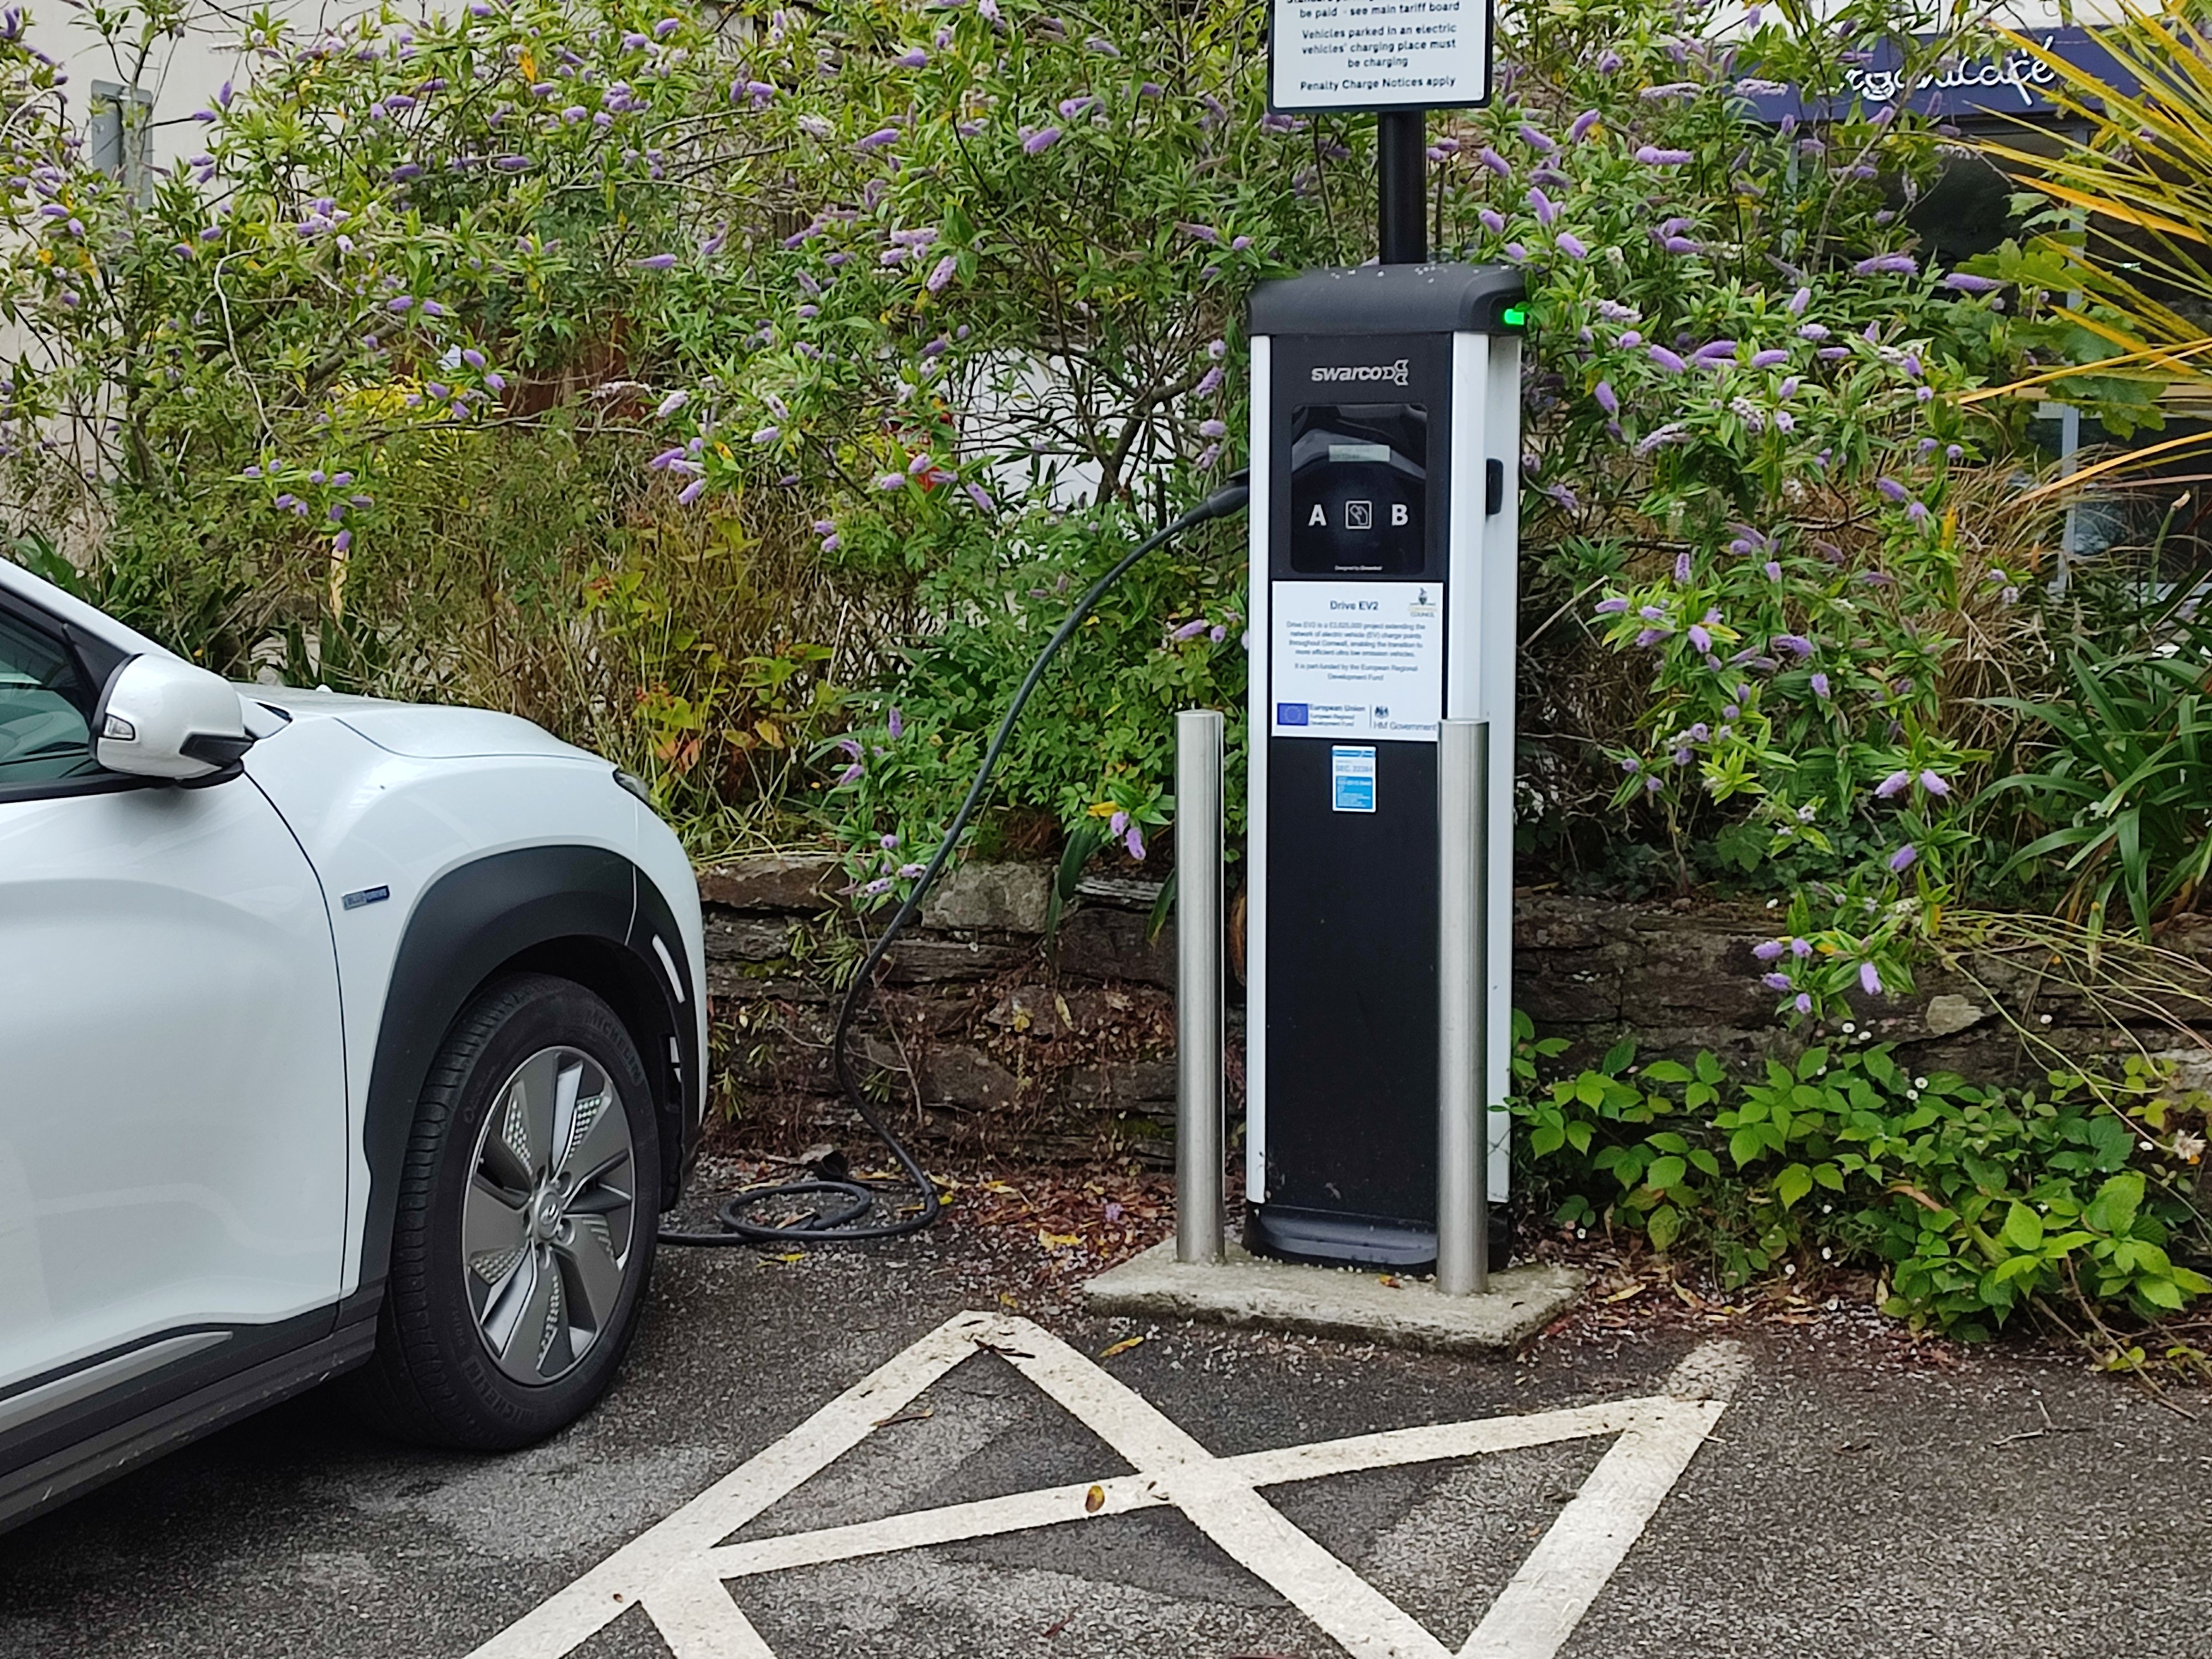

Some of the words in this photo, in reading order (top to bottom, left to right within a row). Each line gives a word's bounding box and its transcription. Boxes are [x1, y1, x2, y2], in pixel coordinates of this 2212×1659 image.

[1300, 8, 1312, 19] be
[1315, 7, 1337, 19] paid
[1350, 7, 1368, 16] see
[1371, 5, 1396, 15] main
[1399, 3, 1426, 13] tariff
[1430, 2, 1460, 12] board
[1302, 28, 1345, 39] Vehicles
[1349, 27, 1384, 38] parked
[1387, 25, 1397, 35] in
[1400, 25, 1412, 34] an
[1416, 23, 1457, 34] electric
[1350, 41, 1394, 53] charging
[1397, 40, 1427, 52] place
[1430, 39, 1456, 49] must
[1348, 57, 1361, 67] be
[1364, 56, 1408, 67] charging
[1301, 80, 1339, 91] Penalty
[1342, 78, 1379, 90] Charge
[1383, 77, 1423, 88] Notices
[1426, 76, 1456, 88] apply
[1308, 504, 1327, 526] A
[1391, 504, 1408, 526] B
[1330, 601, 1355, 610] Drive
[1359, 601, 1379, 611] EV2
